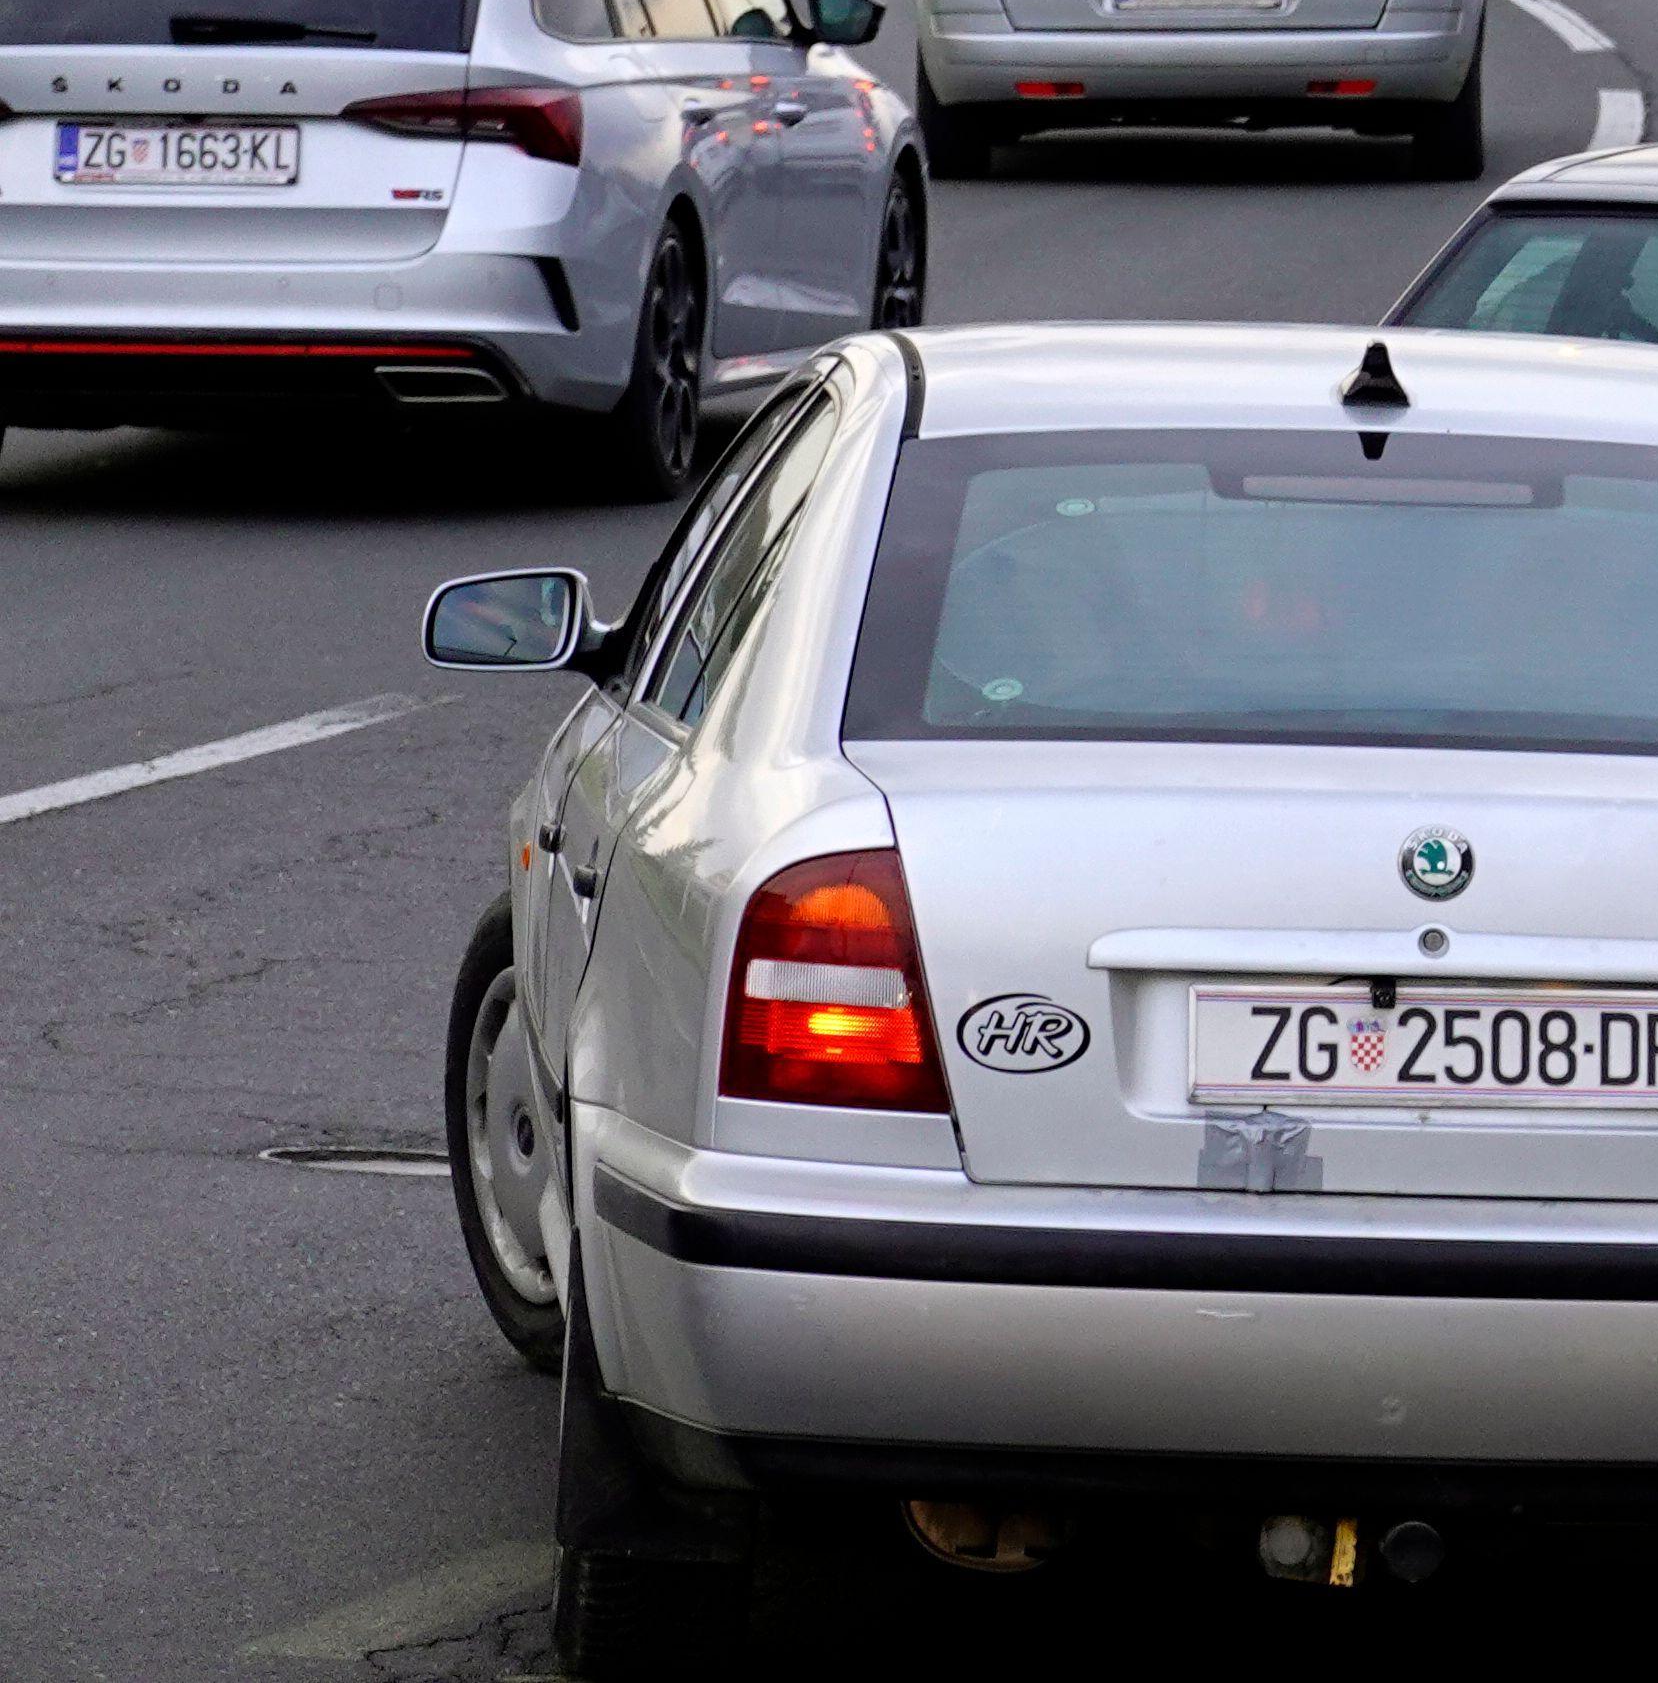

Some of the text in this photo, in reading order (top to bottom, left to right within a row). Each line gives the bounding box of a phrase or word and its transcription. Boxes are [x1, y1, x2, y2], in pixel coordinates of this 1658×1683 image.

[84, 133, 126, 168] ZG
[977, 1010, 1073, 1060] HR
[1251, 1005, 1339, 1082] ZG
